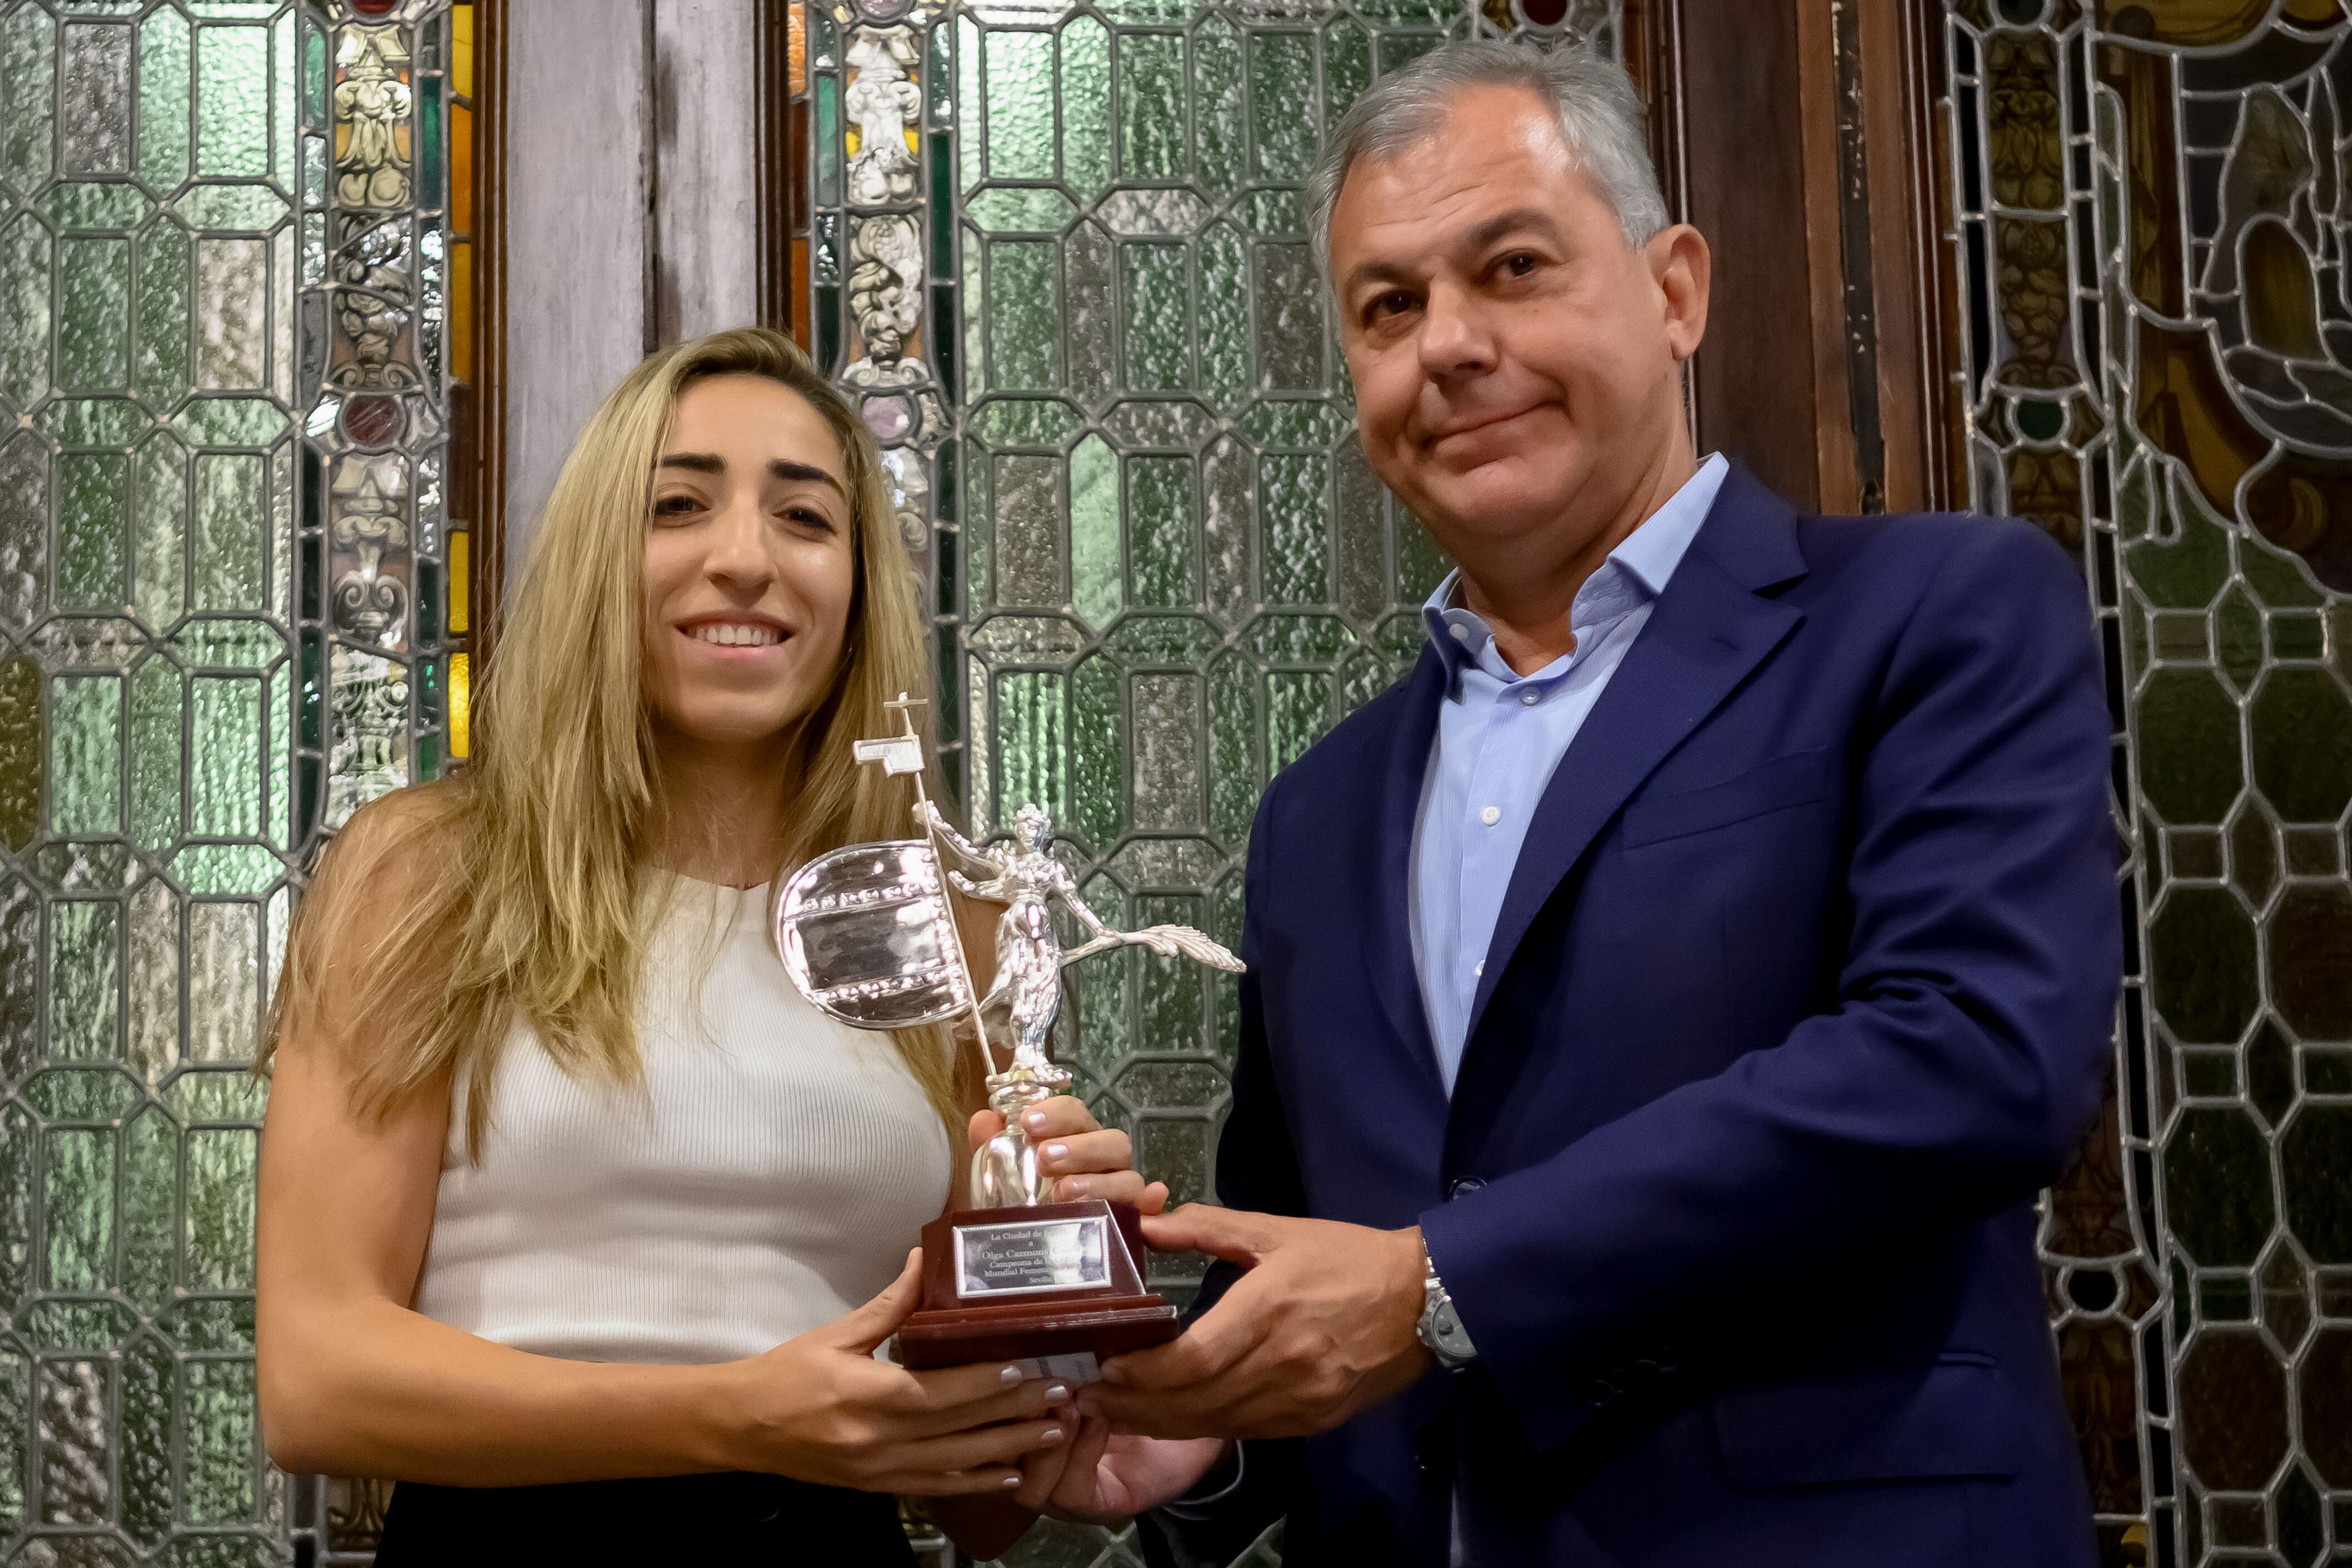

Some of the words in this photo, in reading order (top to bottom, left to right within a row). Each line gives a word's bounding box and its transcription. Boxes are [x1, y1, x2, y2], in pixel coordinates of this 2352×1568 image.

[1002, 1230, 1031, 1239] Ciudad
[982, 1251, 1004, 1261] Olga
[989, 1260, 1031, 1270] Campeona
[984, 1267, 1018, 1277] Mundial
